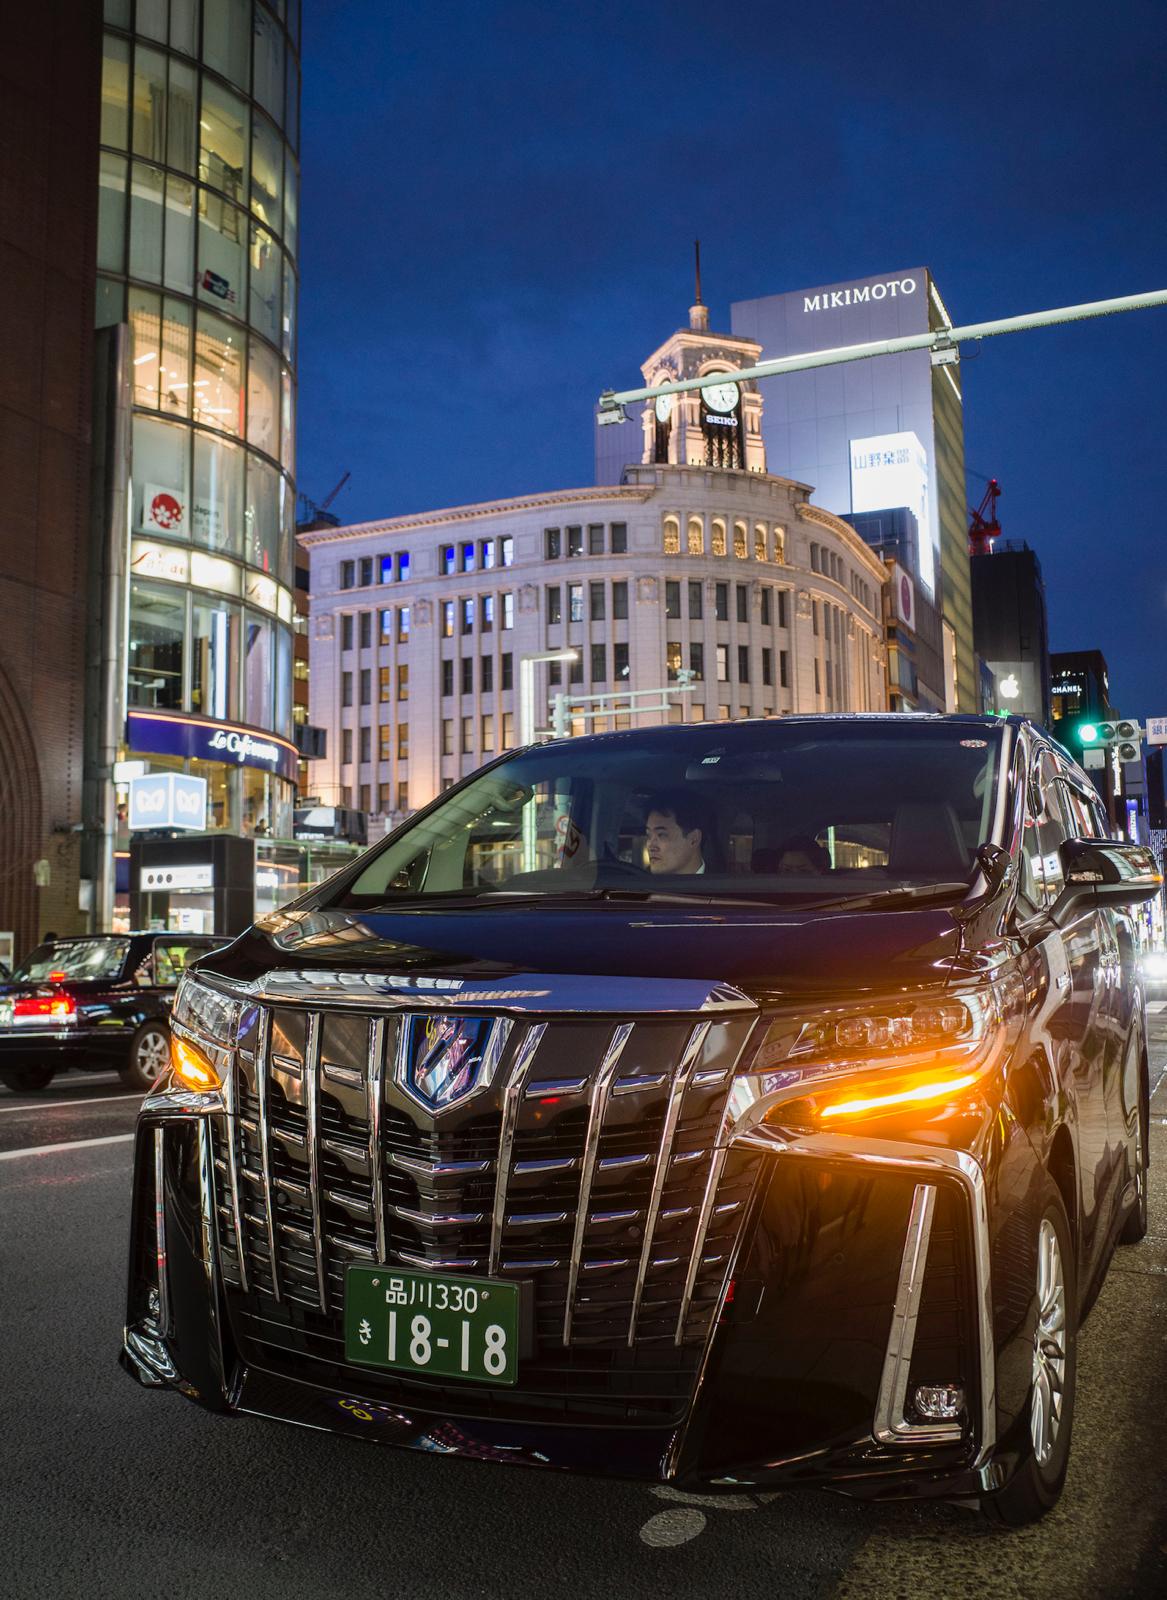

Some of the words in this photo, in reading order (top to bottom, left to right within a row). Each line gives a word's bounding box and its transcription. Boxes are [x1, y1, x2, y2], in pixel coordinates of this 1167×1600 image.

[803, 278, 916, 312] MIKIMOTO
[706, 414, 738, 426] SEIKO
[1051, 684, 1082, 694] CHANEL
[359, 1318, 372, 1345] き
[388, 1311, 507, 1376] 18-18
